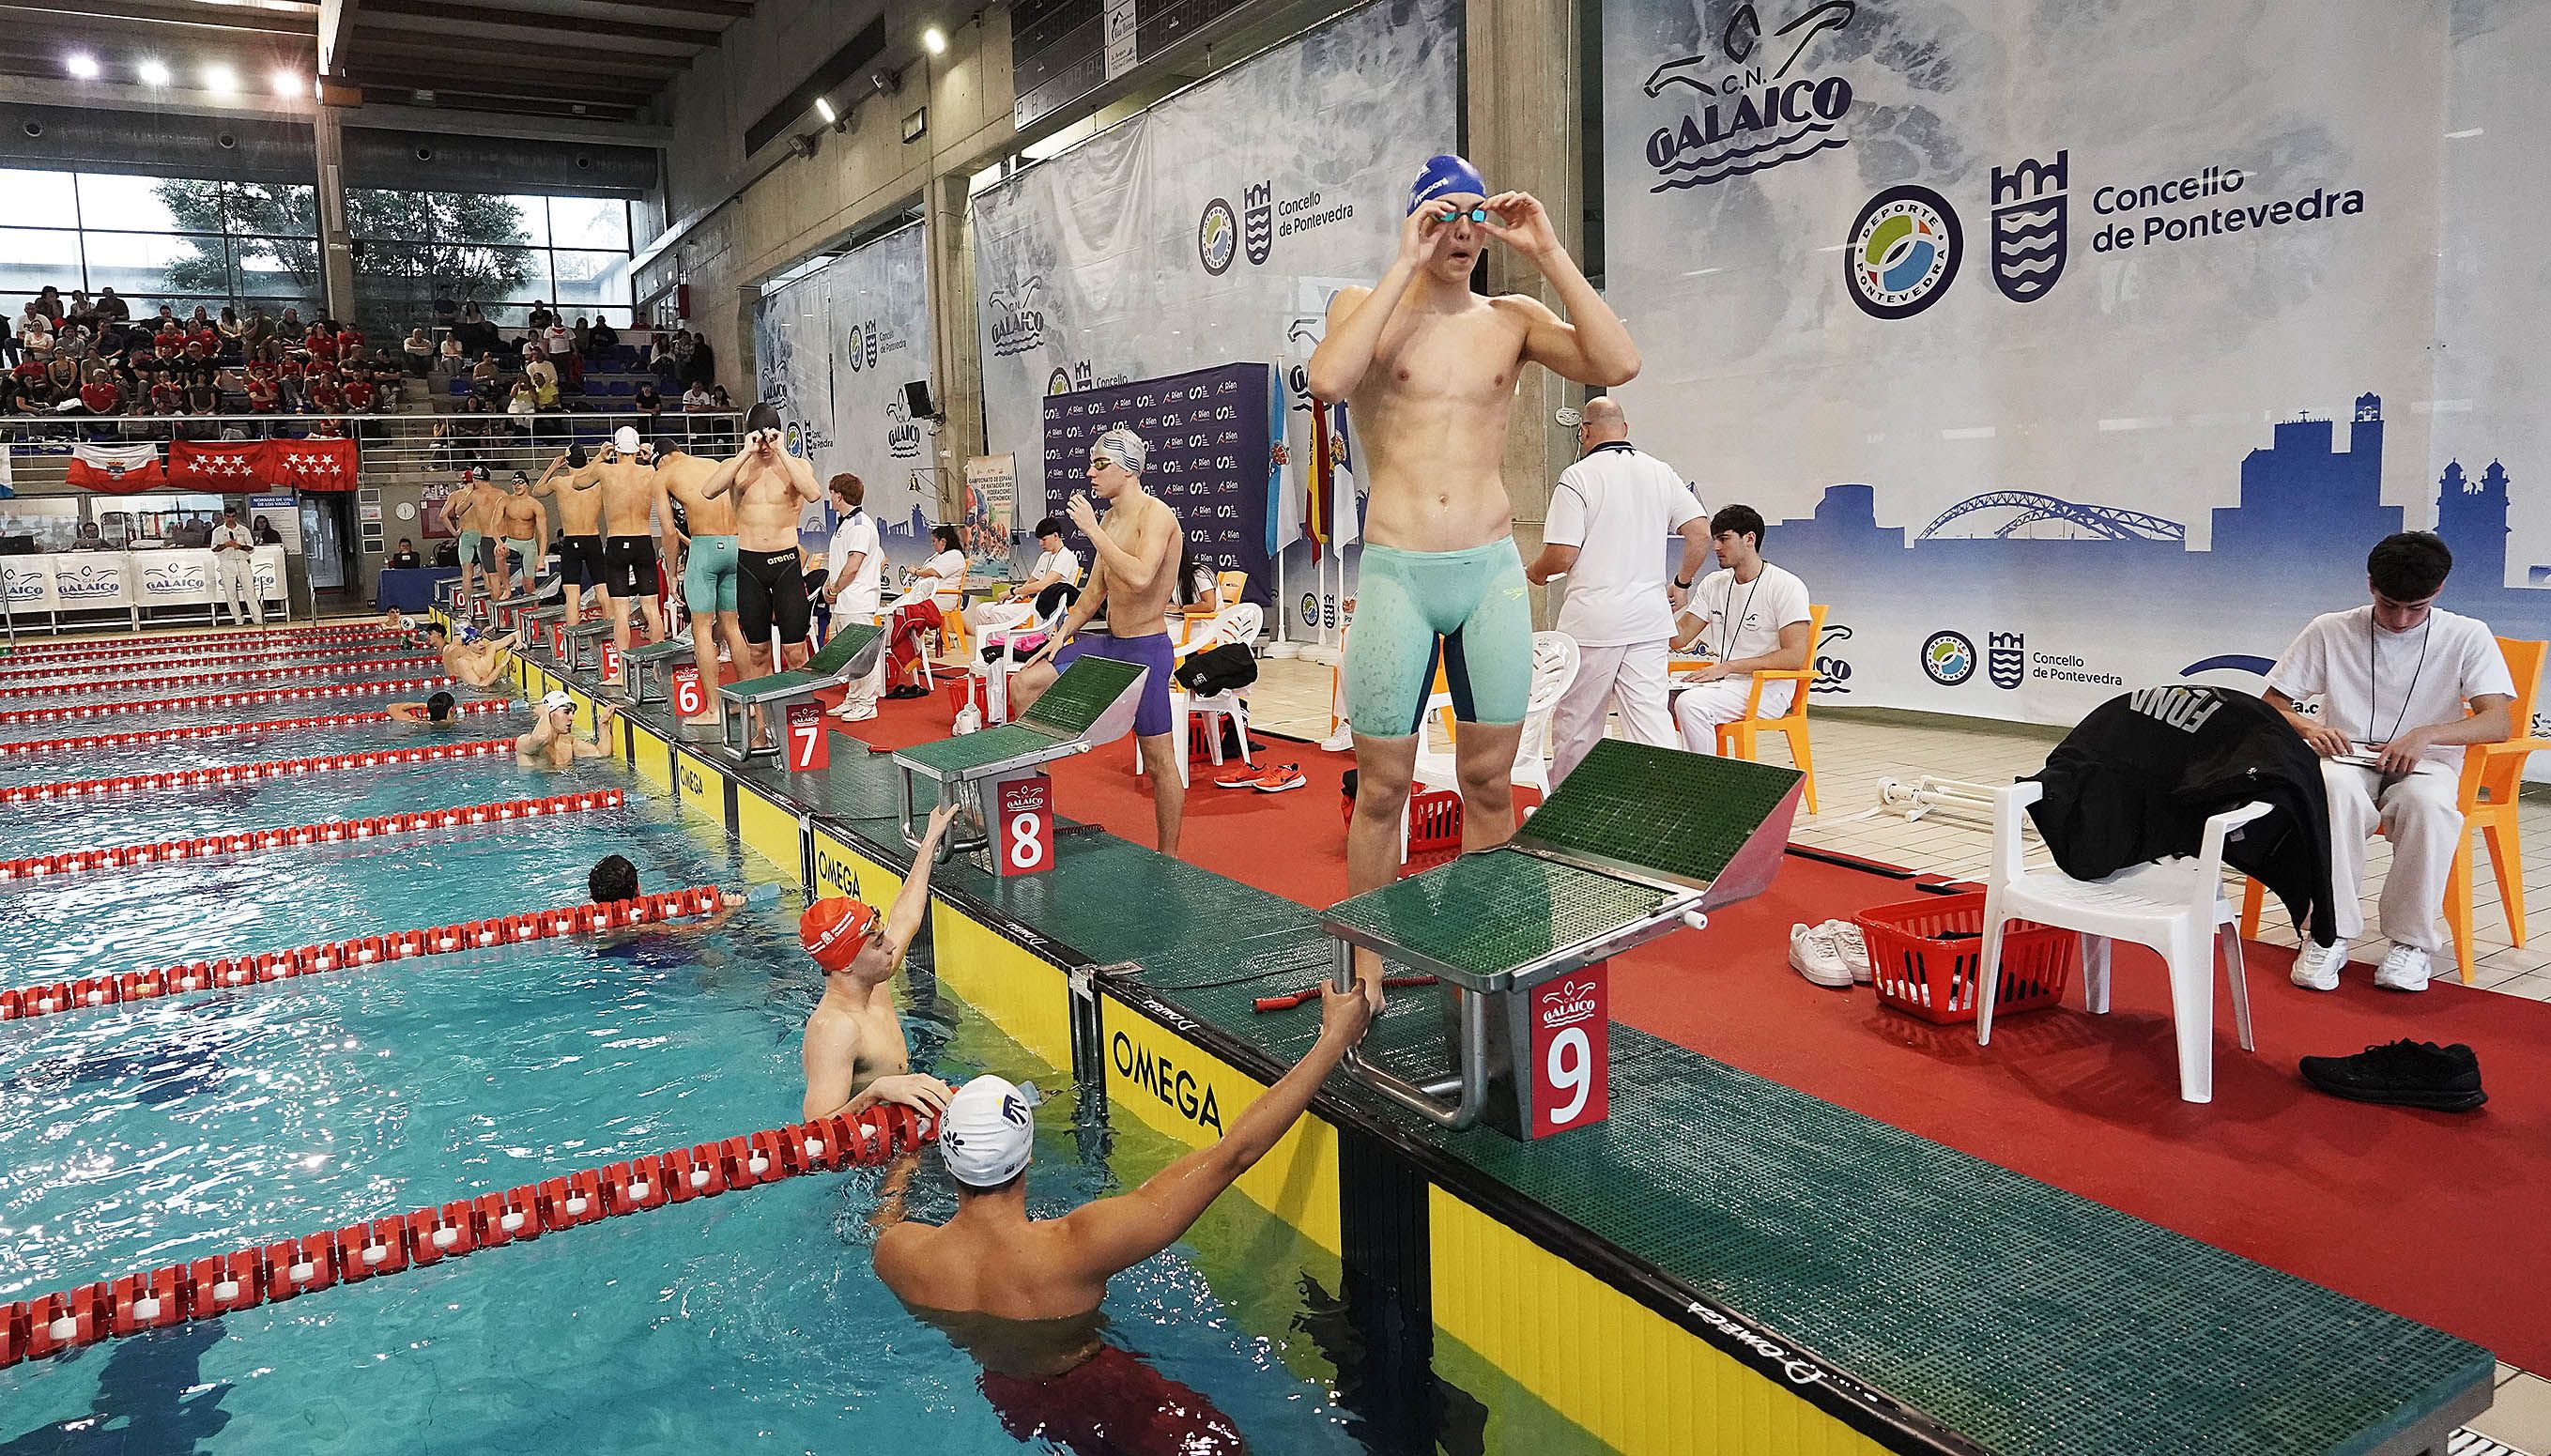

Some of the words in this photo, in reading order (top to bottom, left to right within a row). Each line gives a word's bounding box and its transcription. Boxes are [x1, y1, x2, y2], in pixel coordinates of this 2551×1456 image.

[1721, 67, 1767, 94] C.N.
[1646, 77, 1852, 167] GALAICO
[1278, 191, 1321, 216] Concello
[2093, 165, 2244, 215] Concello
[1279, 221, 1293, 237] de
[1295, 204, 1354, 234] Pontevedra
[1862, 204, 1939, 238] DEPORTE
[2093, 222, 2134, 253] de
[2144, 188, 2364, 245] Pontevedra
[1856, 249, 1945, 303] PONTEVEDRA
[766, 552, 796, 565] arena
[58, 582, 119, 593] GALAICO
[146, 578, 205, 590] GALAICO
[456, 594, 465, 606] 0
[473, 601, 484, 616] 1
[1930, 637, 1967, 651] DEPORTE
[608, 653, 620, 679] 5
[1928, 658, 1970, 680] PONTEVEDRA
[2033, 651, 2084, 667] Concello
[2033, 667, 2048, 679] de
[2051, 668, 2123, 686] Pontevedra
[679, 682, 699, 713] 6
[794, 727, 818, 767] 7
[680, 764, 704, 798] OMEGA
[1007, 797, 1044, 808] GALAICO
[1011, 812, 1043, 868] 8
[818, 850, 862, 901] OMEGA
[1543, 999, 1595, 1022] GALAICO
[1113, 1031, 1224, 1140] OMEGA
[1547, 1027, 1591, 1125] 9
